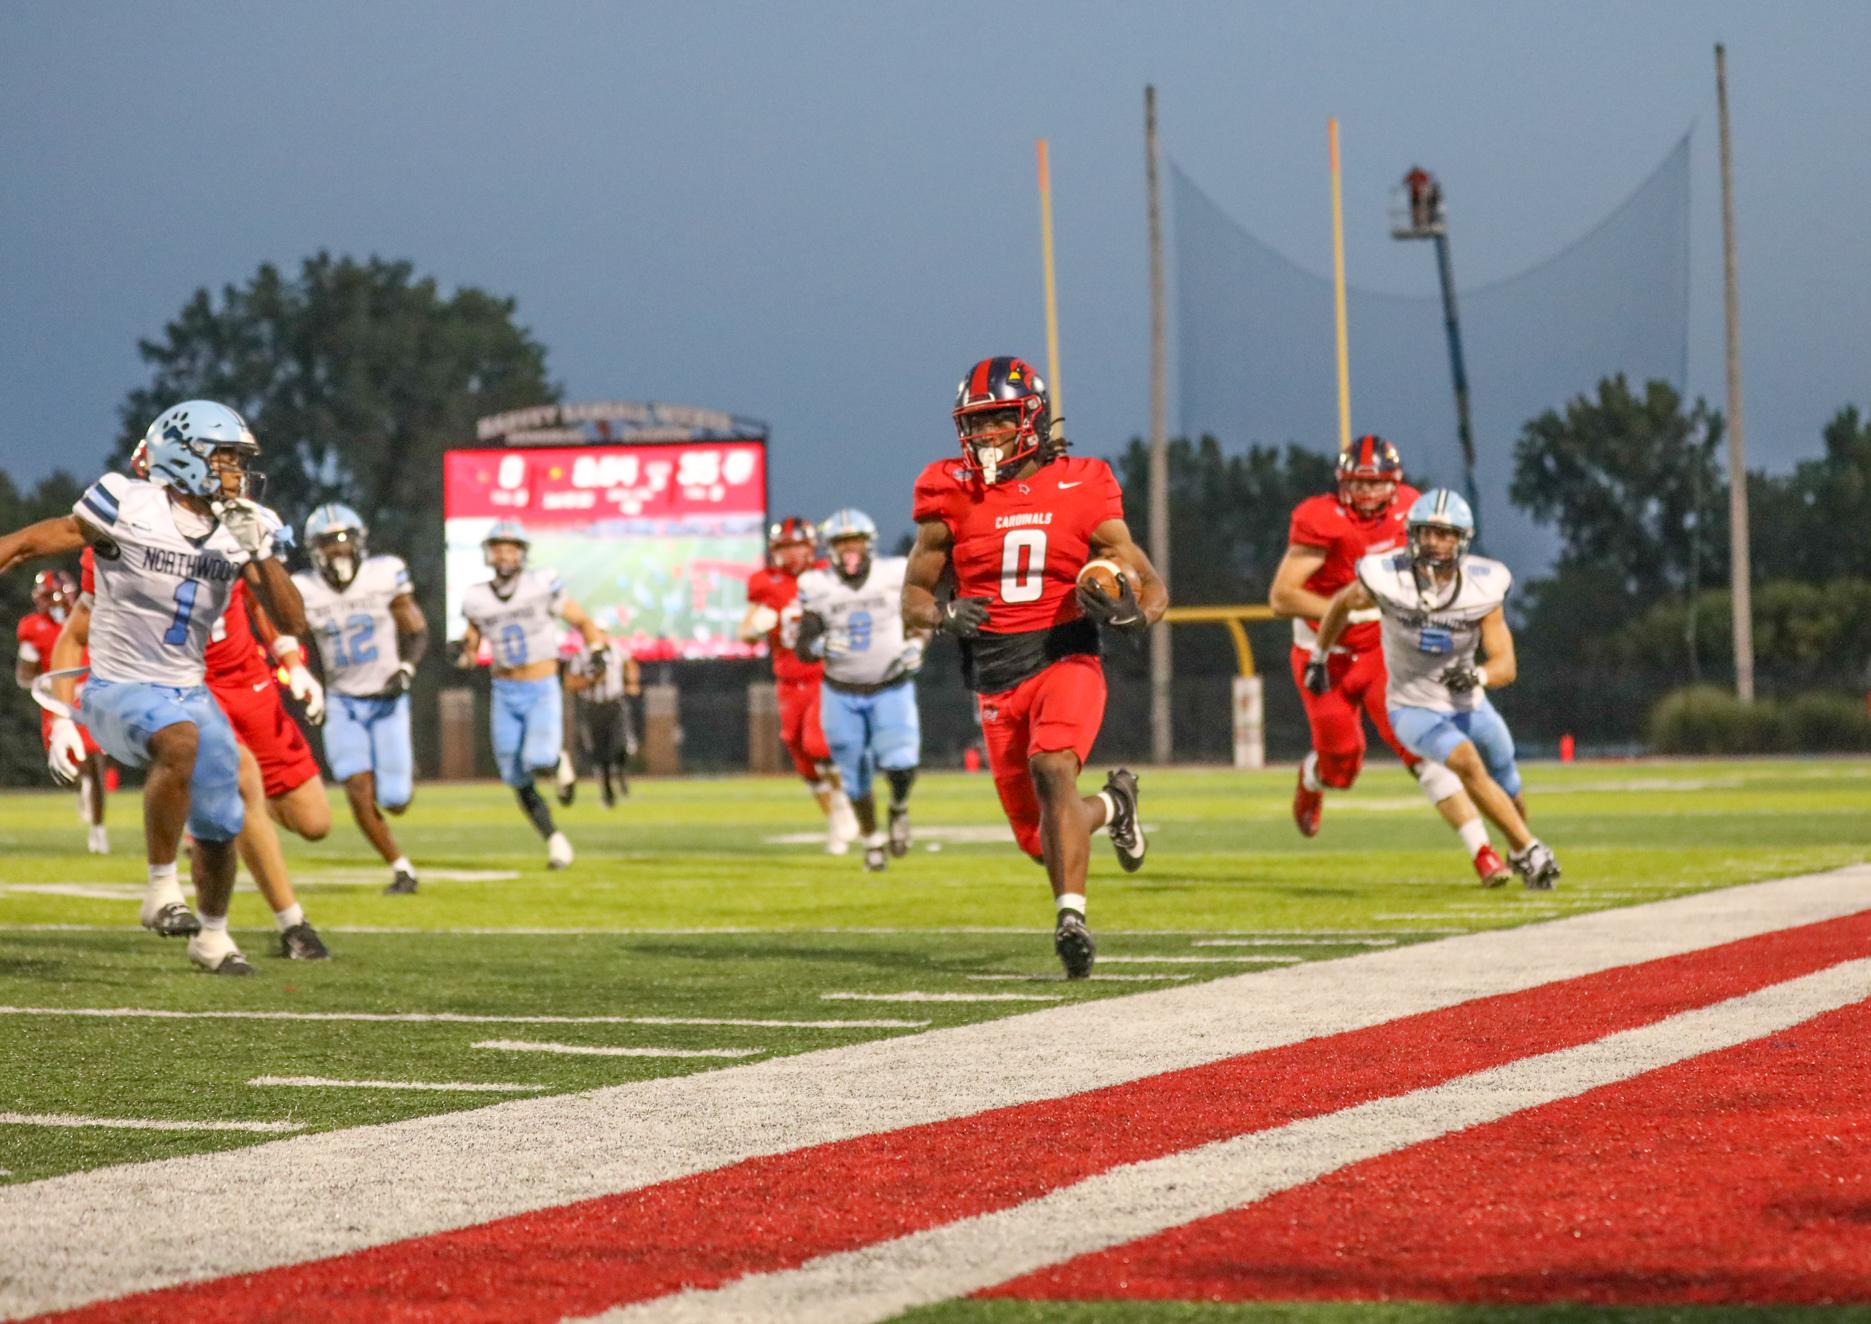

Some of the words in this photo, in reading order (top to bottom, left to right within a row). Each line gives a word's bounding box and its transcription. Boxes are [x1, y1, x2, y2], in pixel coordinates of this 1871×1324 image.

[995, 512, 1053, 529] CARDINALS
[1000, 528, 1047, 604] 0
[163, 577, 199, 646] 1
[325, 613, 379, 668] 12
[501, 623, 529, 667] 0
